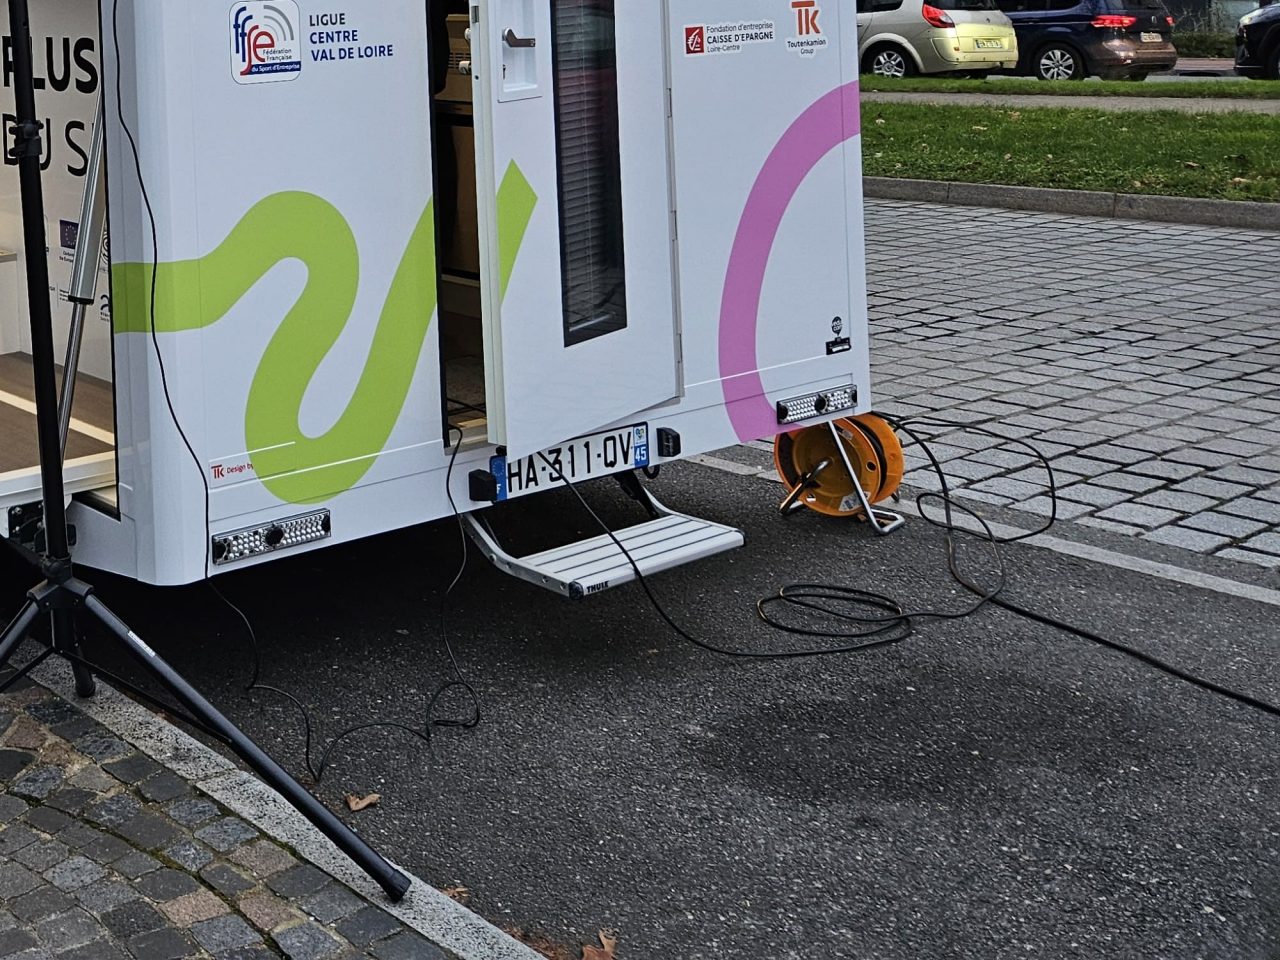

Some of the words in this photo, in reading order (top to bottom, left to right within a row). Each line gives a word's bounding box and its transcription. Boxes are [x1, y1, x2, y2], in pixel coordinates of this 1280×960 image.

[309, 13, 346, 27] LIGUE
[706, 24, 736, 33] Fondation
[738, 21, 773, 31] d'entreprise
[309, 30, 358, 44] CENTRE
[707, 34, 732, 44] CAISSE
[735, 31, 773, 42] D'EPARGNE
[311, 48, 335, 61] VAL
[339, 47, 354, 59] DE
[358, 44, 394, 58] LOIRE
[258, 64, 271, 73] Sport
[635, 446, 647, 461] 45
